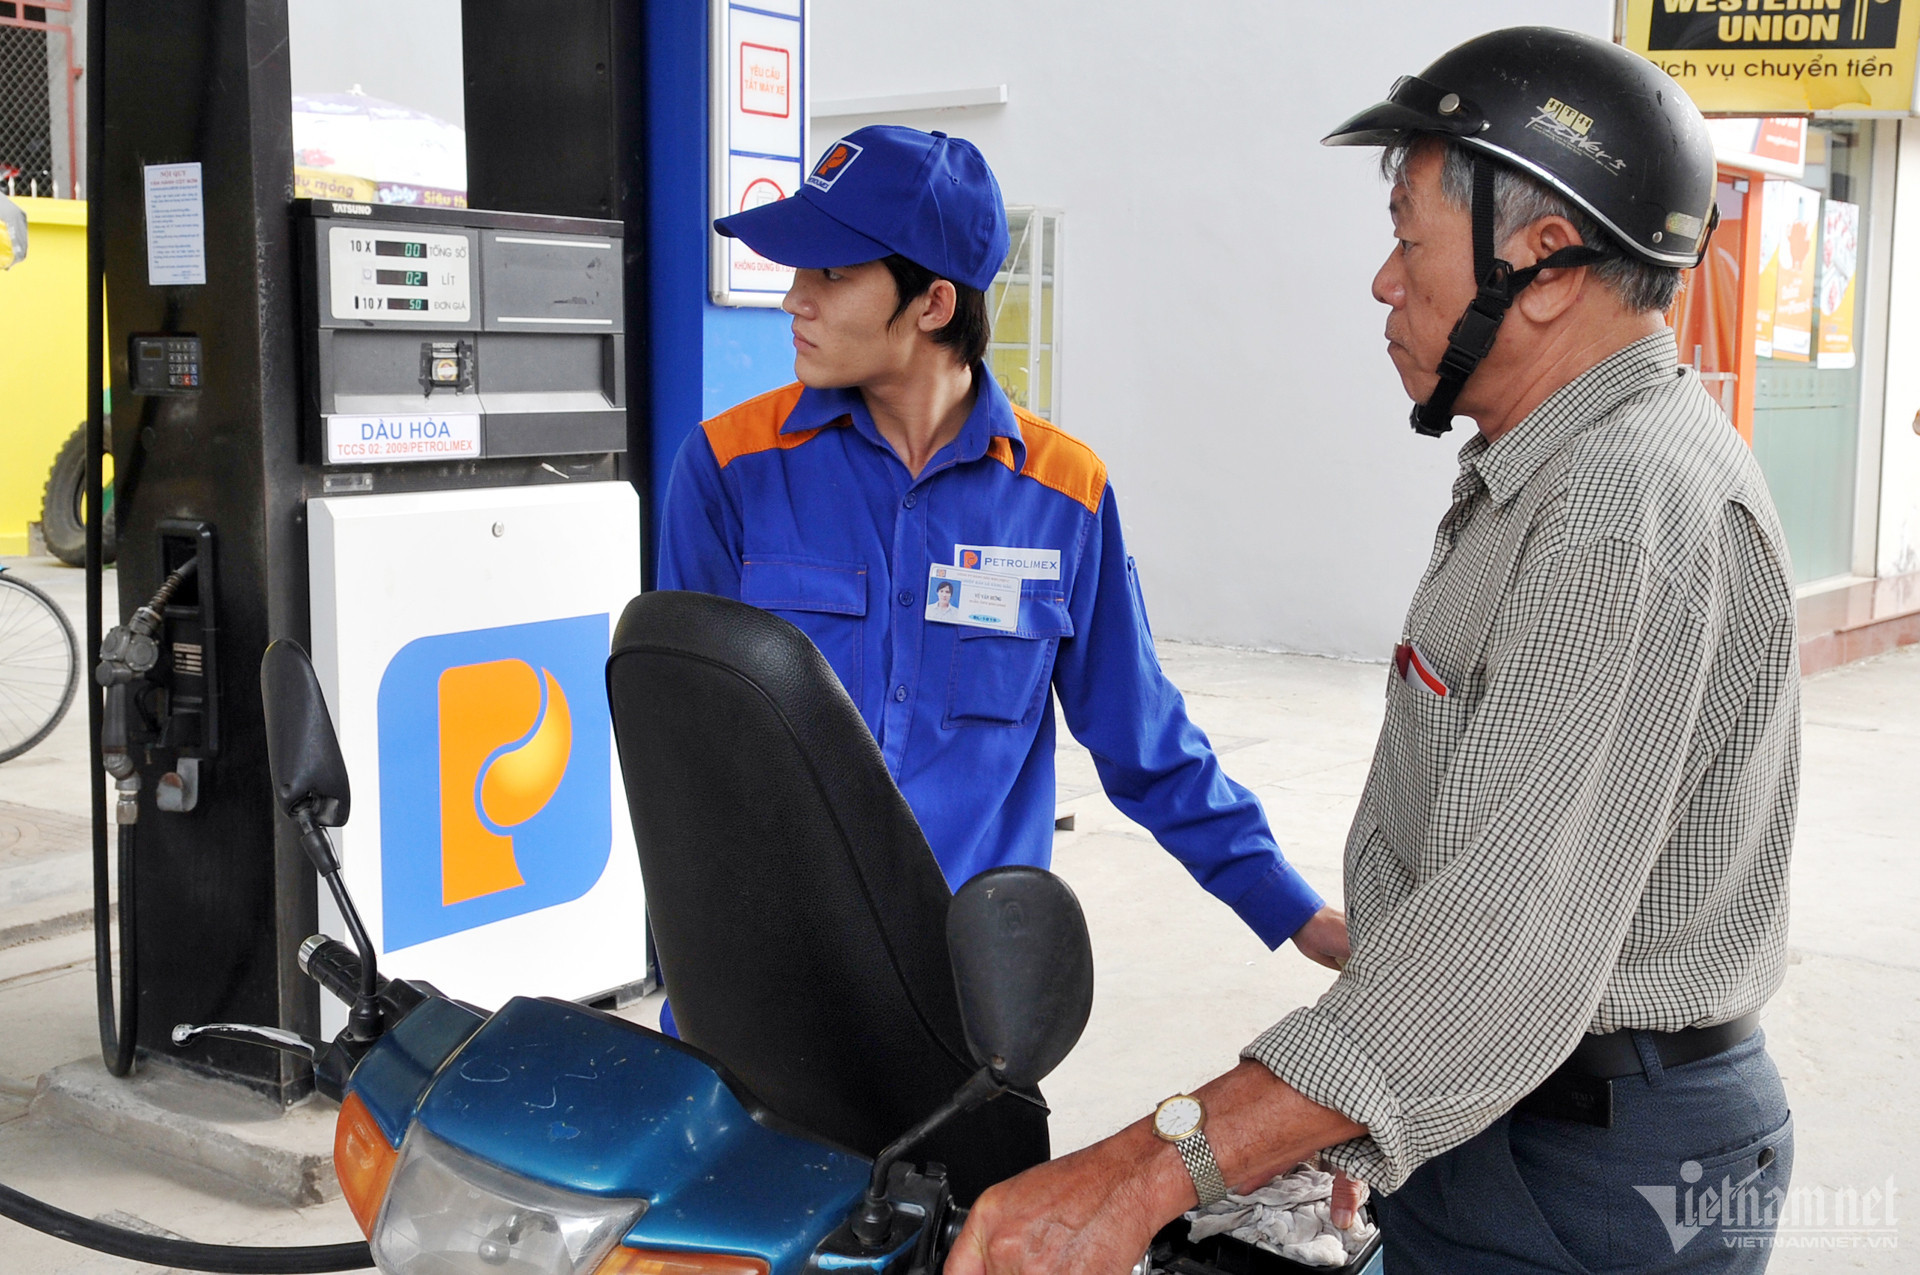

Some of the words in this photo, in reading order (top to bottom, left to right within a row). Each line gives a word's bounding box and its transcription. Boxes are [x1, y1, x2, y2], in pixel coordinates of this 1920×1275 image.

[1718, 14, 1840, 42] UNION
[1706, 62, 1735, 81] vụ
[1744, 55, 1838, 81] chuyển
[1847, 56, 1893, 78] tiền
[315, 178, 354, 198] mỏng
[424, 190, 451, 206] Siêu
[332, 203, 372, 216] TATSUNO
[350, 239, 362, 253] 10
[404, 243, 421, 258] 00
[405, 271, 422, 286] 02
[441, 273, 456, 286] LÍT
[337, 444, 366, 456] TCCS
[984, 557, 1058, 570] PETROLIMEX
[438, 658, 572, 907] P
